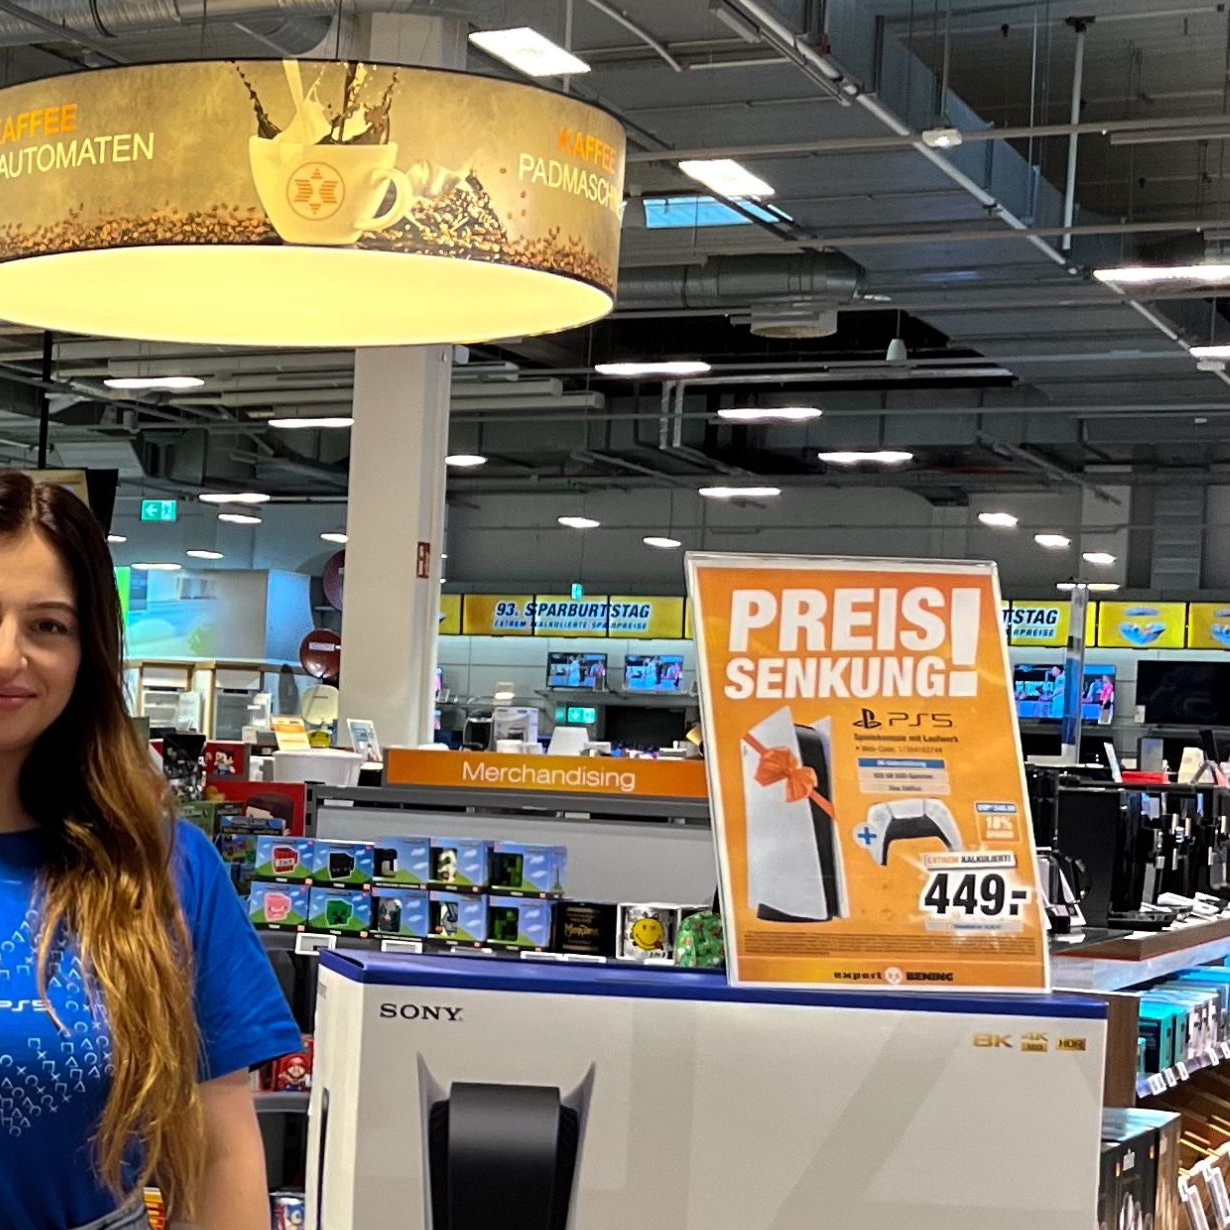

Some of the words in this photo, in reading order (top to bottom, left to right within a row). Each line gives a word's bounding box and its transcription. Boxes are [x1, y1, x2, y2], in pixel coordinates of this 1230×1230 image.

[557, 126, 616, 174] KAFFEE
[496, 602, 518, 617] 93.
[888, 711, 954, 728] PS5
[462, 761, 637, 792] Merchandising
[380, 1003, 463, 1022] SONY
[973, 1033, 1013, 1048] 8K
